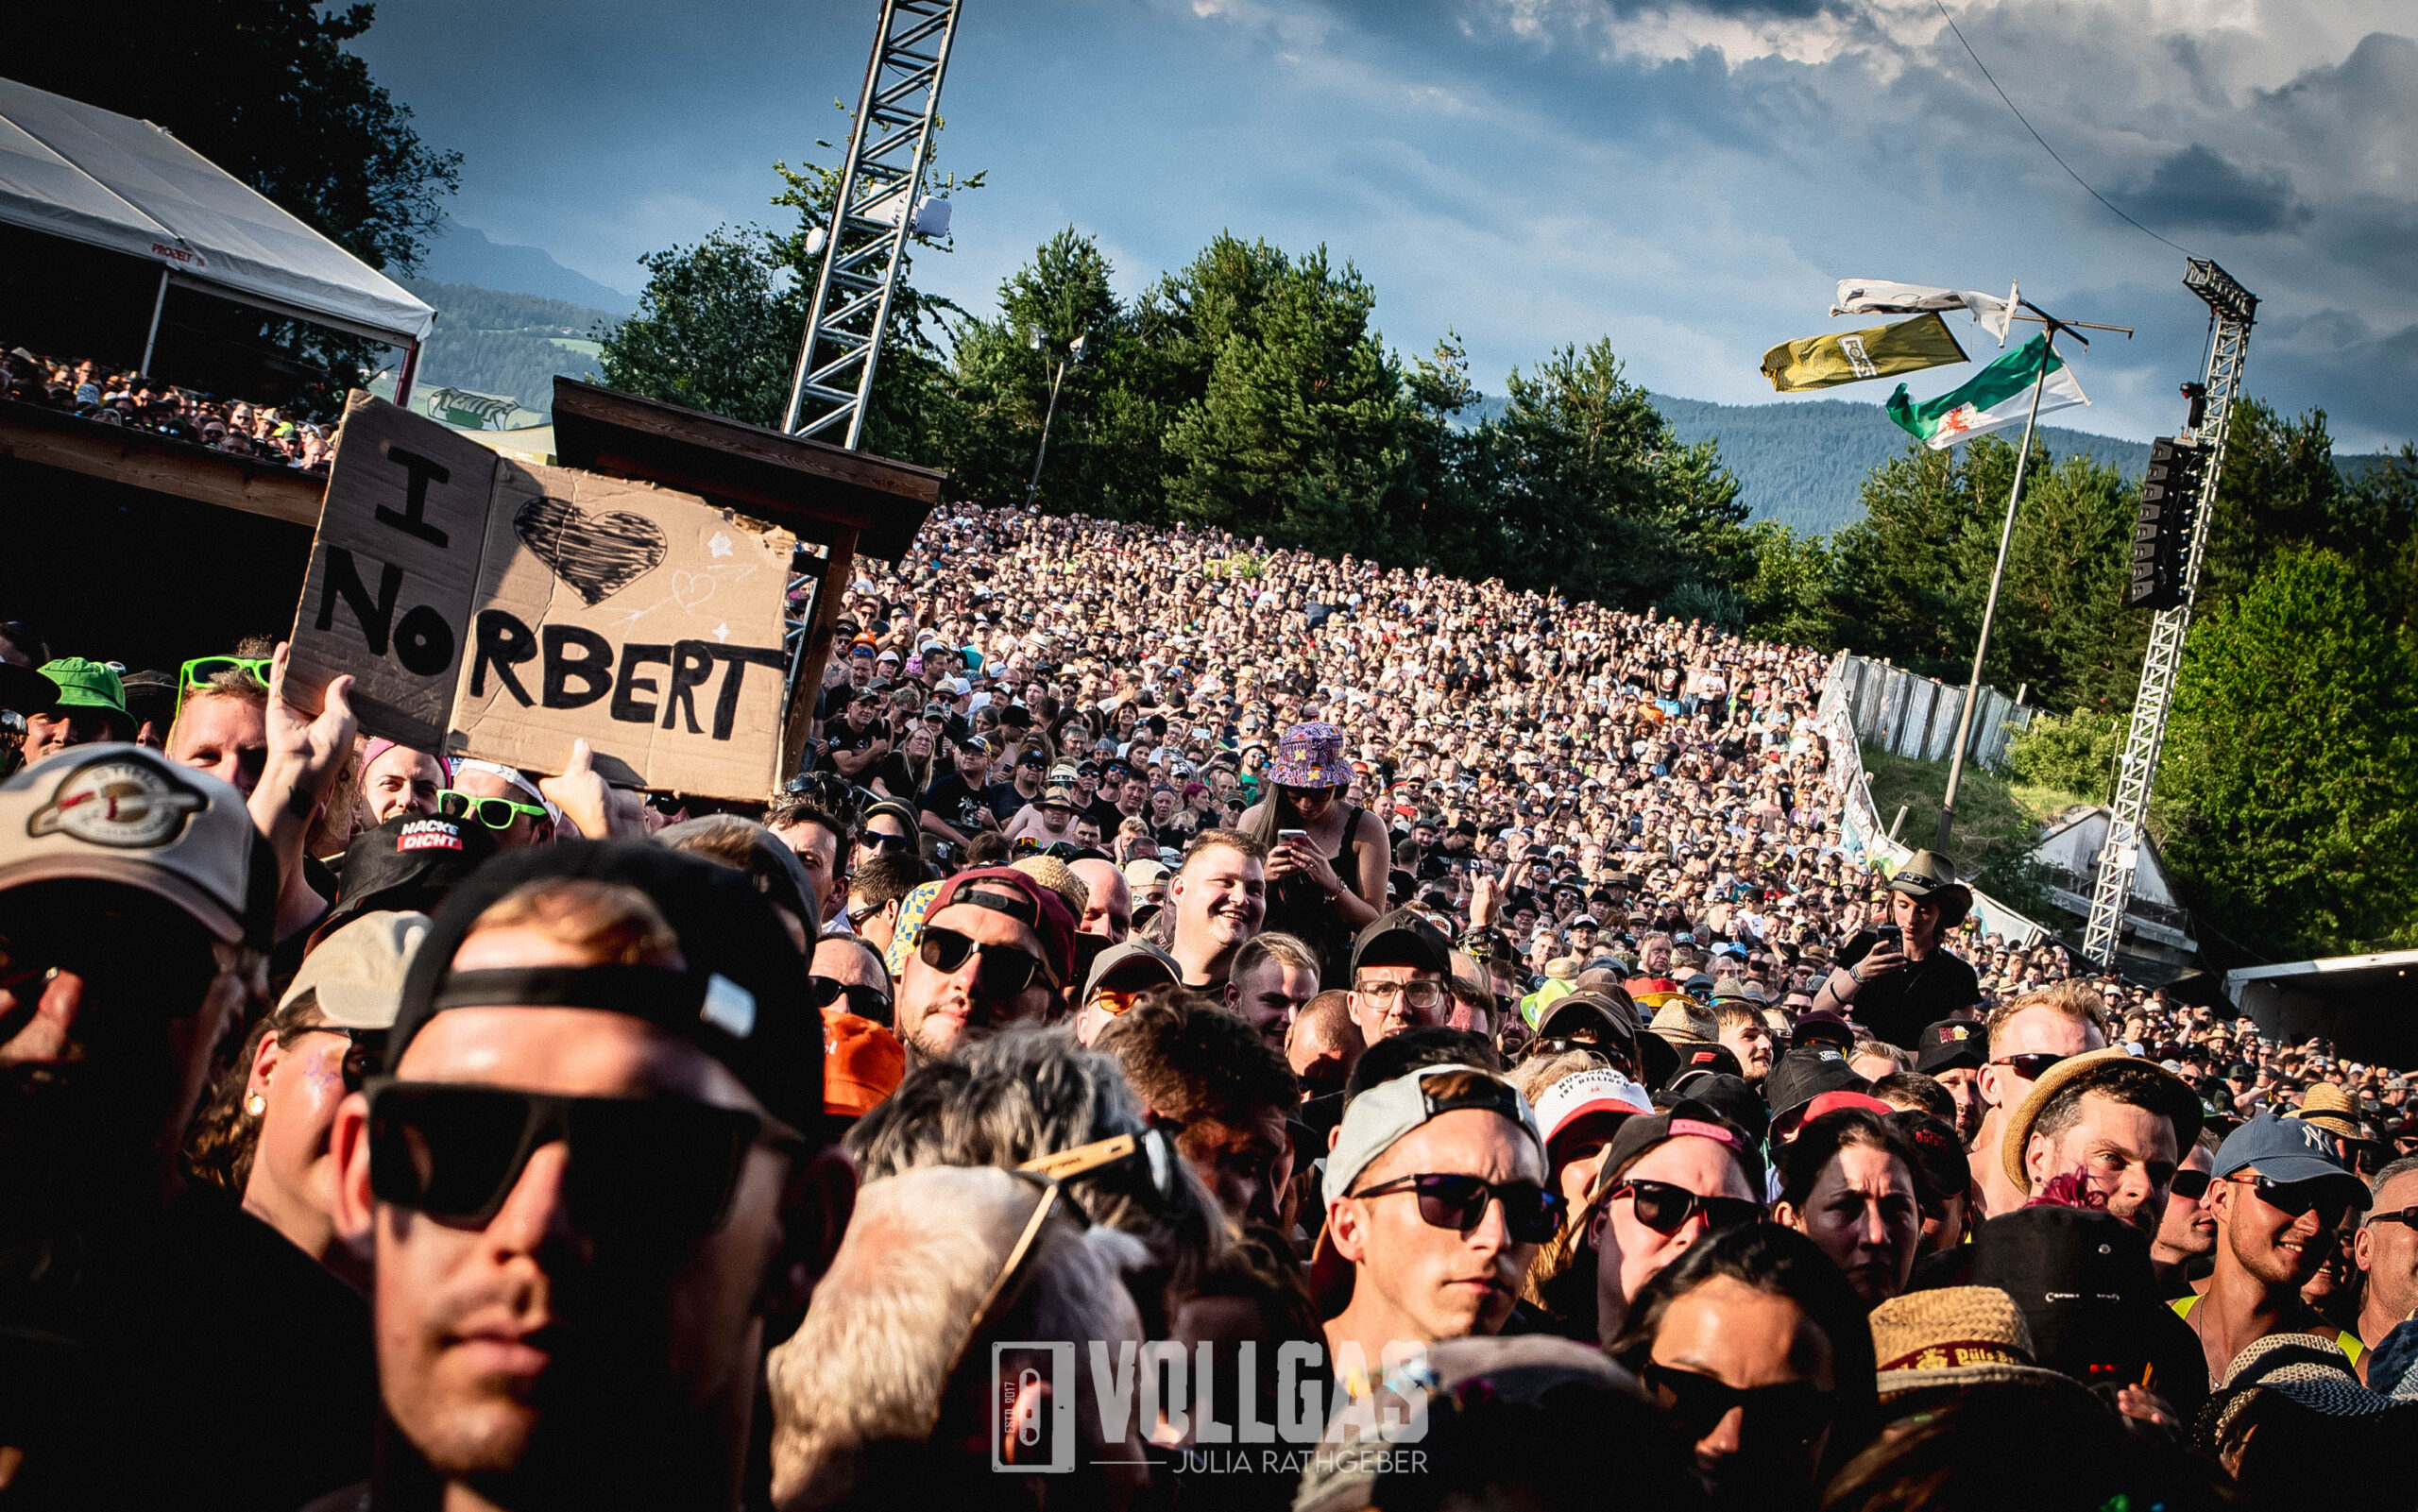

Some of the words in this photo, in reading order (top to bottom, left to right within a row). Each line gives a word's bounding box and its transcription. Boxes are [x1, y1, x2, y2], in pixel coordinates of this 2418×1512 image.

[375, 445, 451, 549] I
[315, 545, 786, 740] NORBERT
[401, 819, 459, 835] HACKE
[403, 833, 458, 849] DICHT
